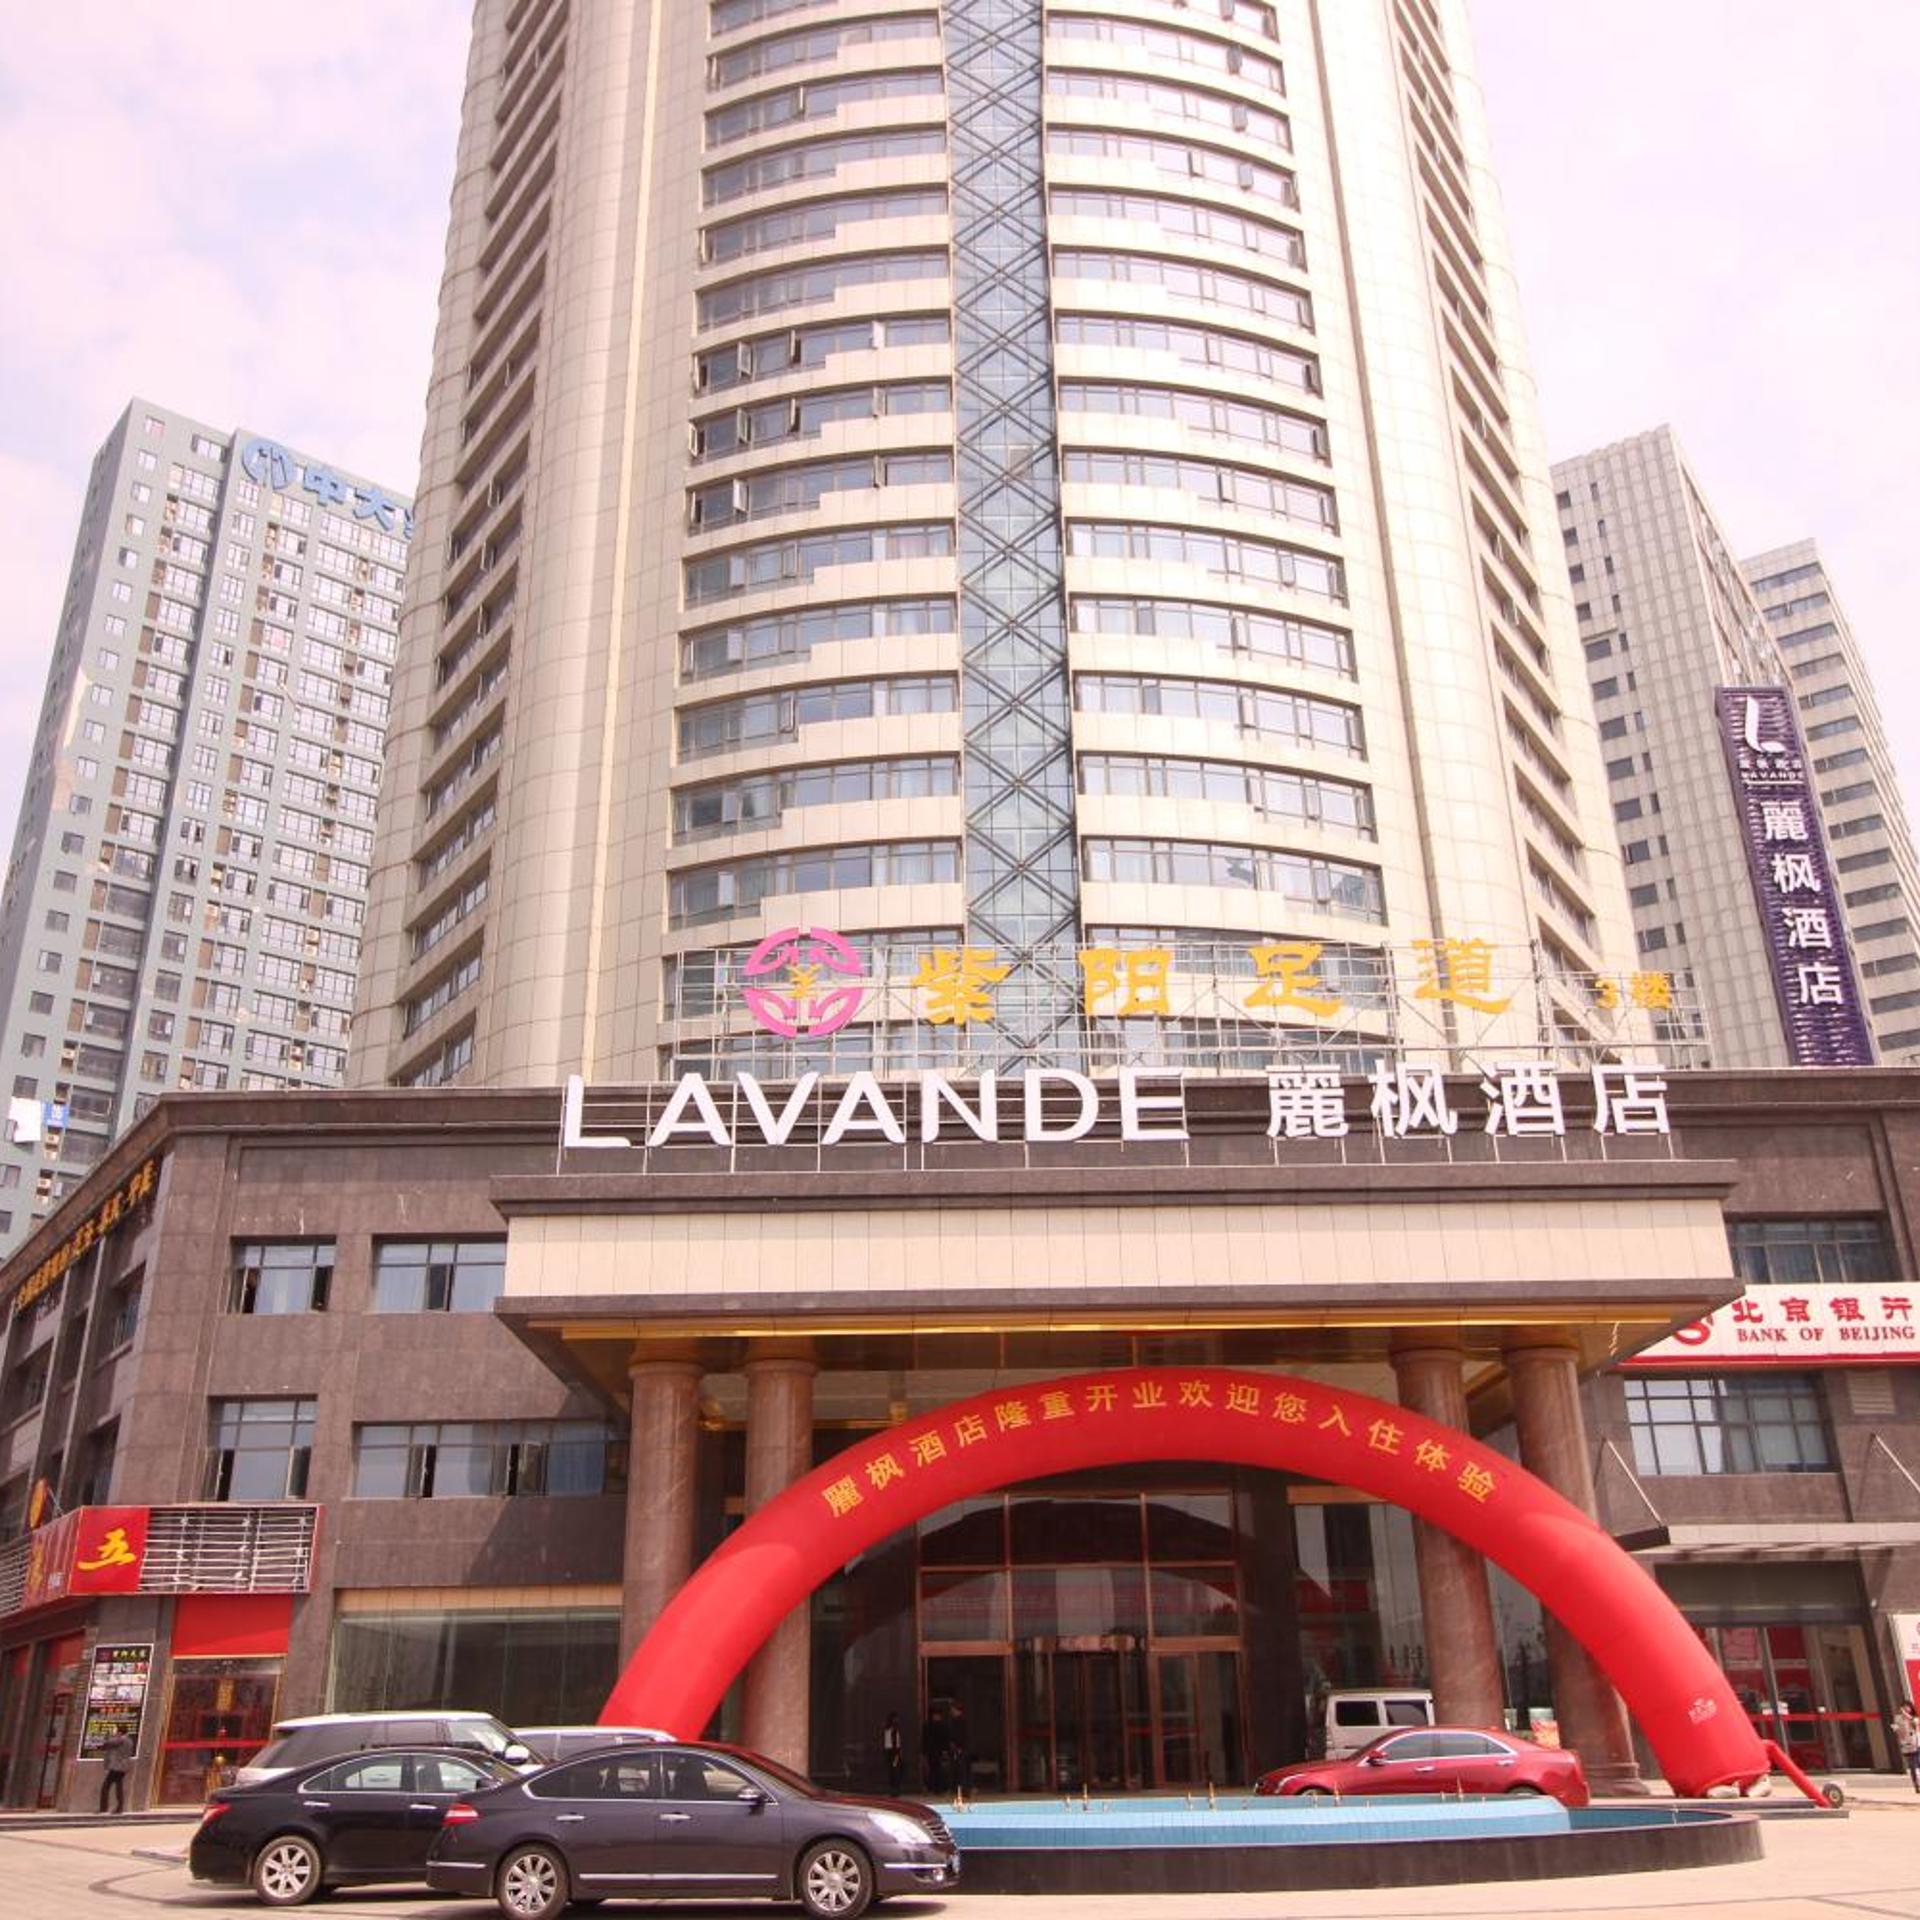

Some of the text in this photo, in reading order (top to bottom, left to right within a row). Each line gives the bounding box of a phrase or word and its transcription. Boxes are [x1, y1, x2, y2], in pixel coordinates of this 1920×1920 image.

[914, 937, 1512, 1025] 紫阳足道
[564, 1059, 1670, 1147] LAVANDE 麗枫酒店
[1732, 1297, 1913, 1323] 北京银行
[1737, 1325, 1916, 1342] BANK OF BEIJING
